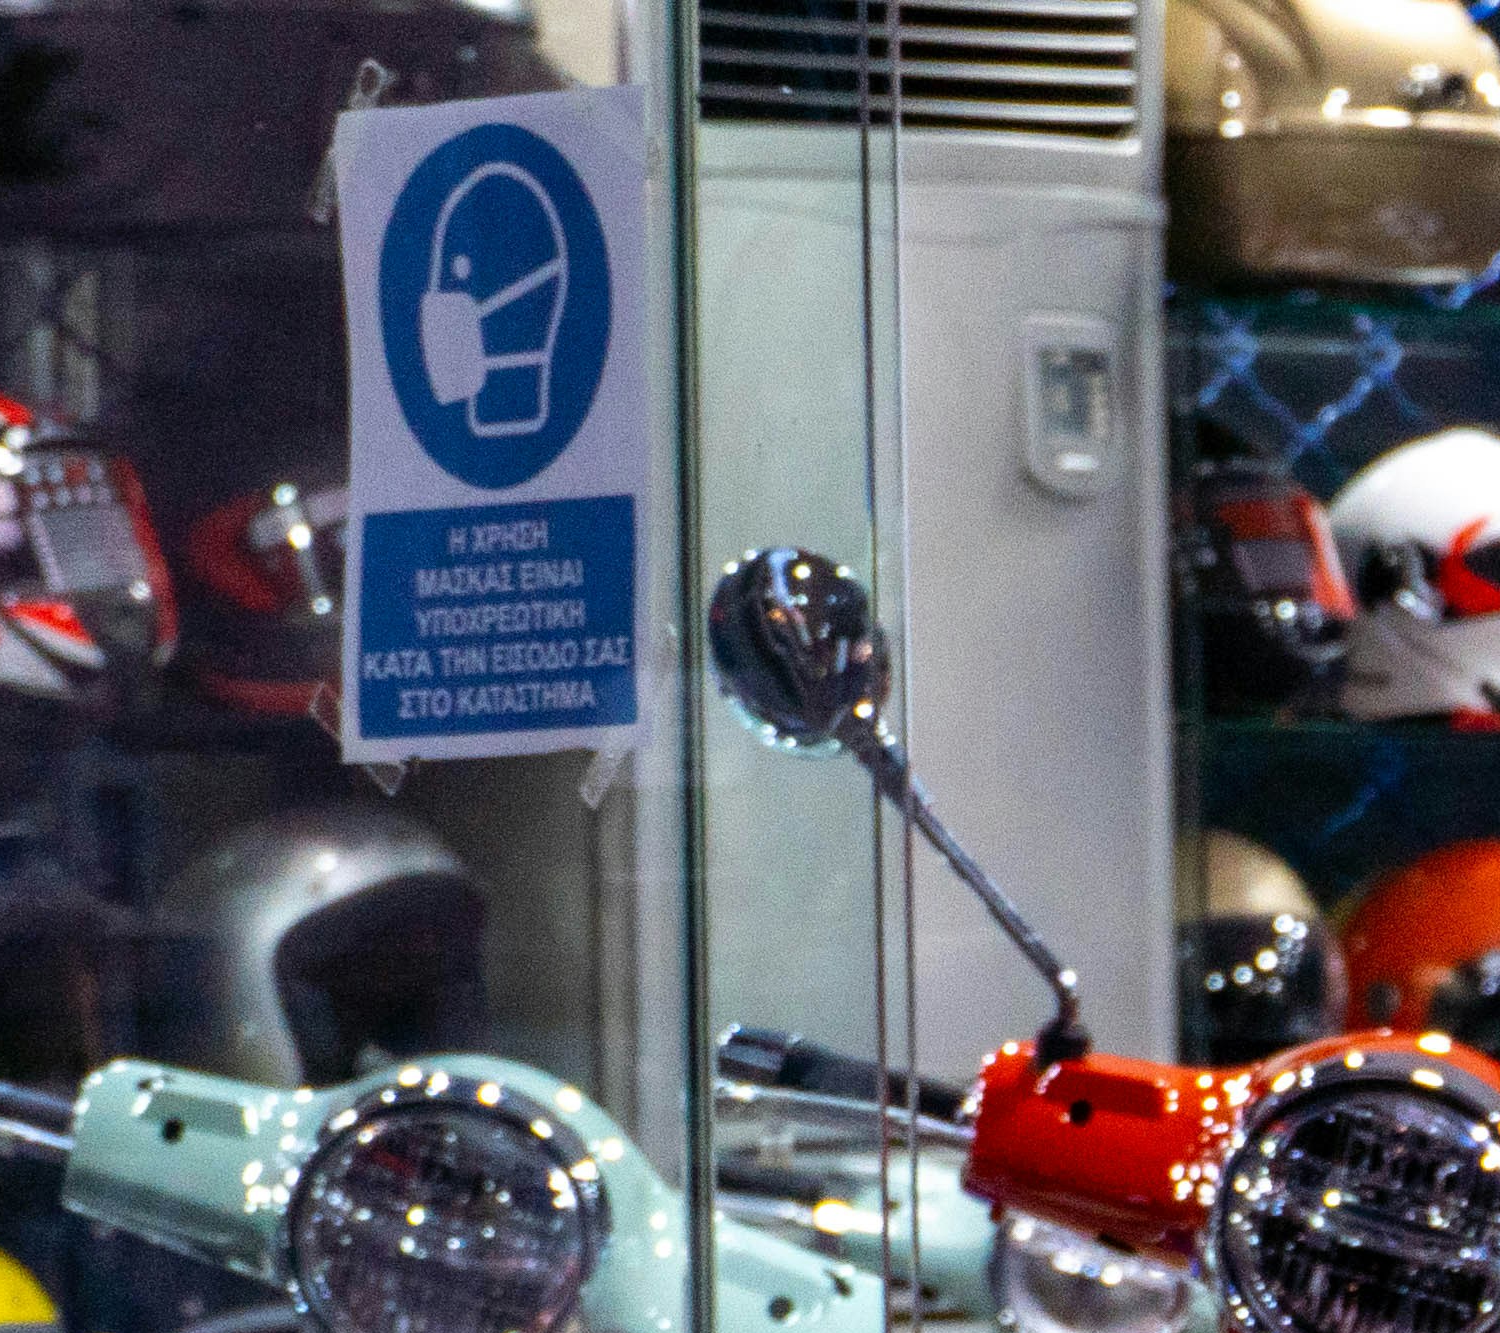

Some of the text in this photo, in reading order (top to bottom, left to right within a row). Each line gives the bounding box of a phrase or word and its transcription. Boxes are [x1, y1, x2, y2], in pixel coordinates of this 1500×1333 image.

[448, 520, 550, 554] Η ΧΡΗΣΗ
[415, 559, 584, 598] ΜΑΣΚΑΣ ΕΙΝΑΙ
[415, 599, 587, 637] ΥΠΟΧΡΕΩΤΙΚΗ
[364, 636, 631, 680] ΚΑΤΑ ΤΗΝ ΕΙΣΟΔΟ ΣΑΣ
[399, 680, 598, 720] ΣΤΟ ΚΑΤΑΣΤΗΜΑ
